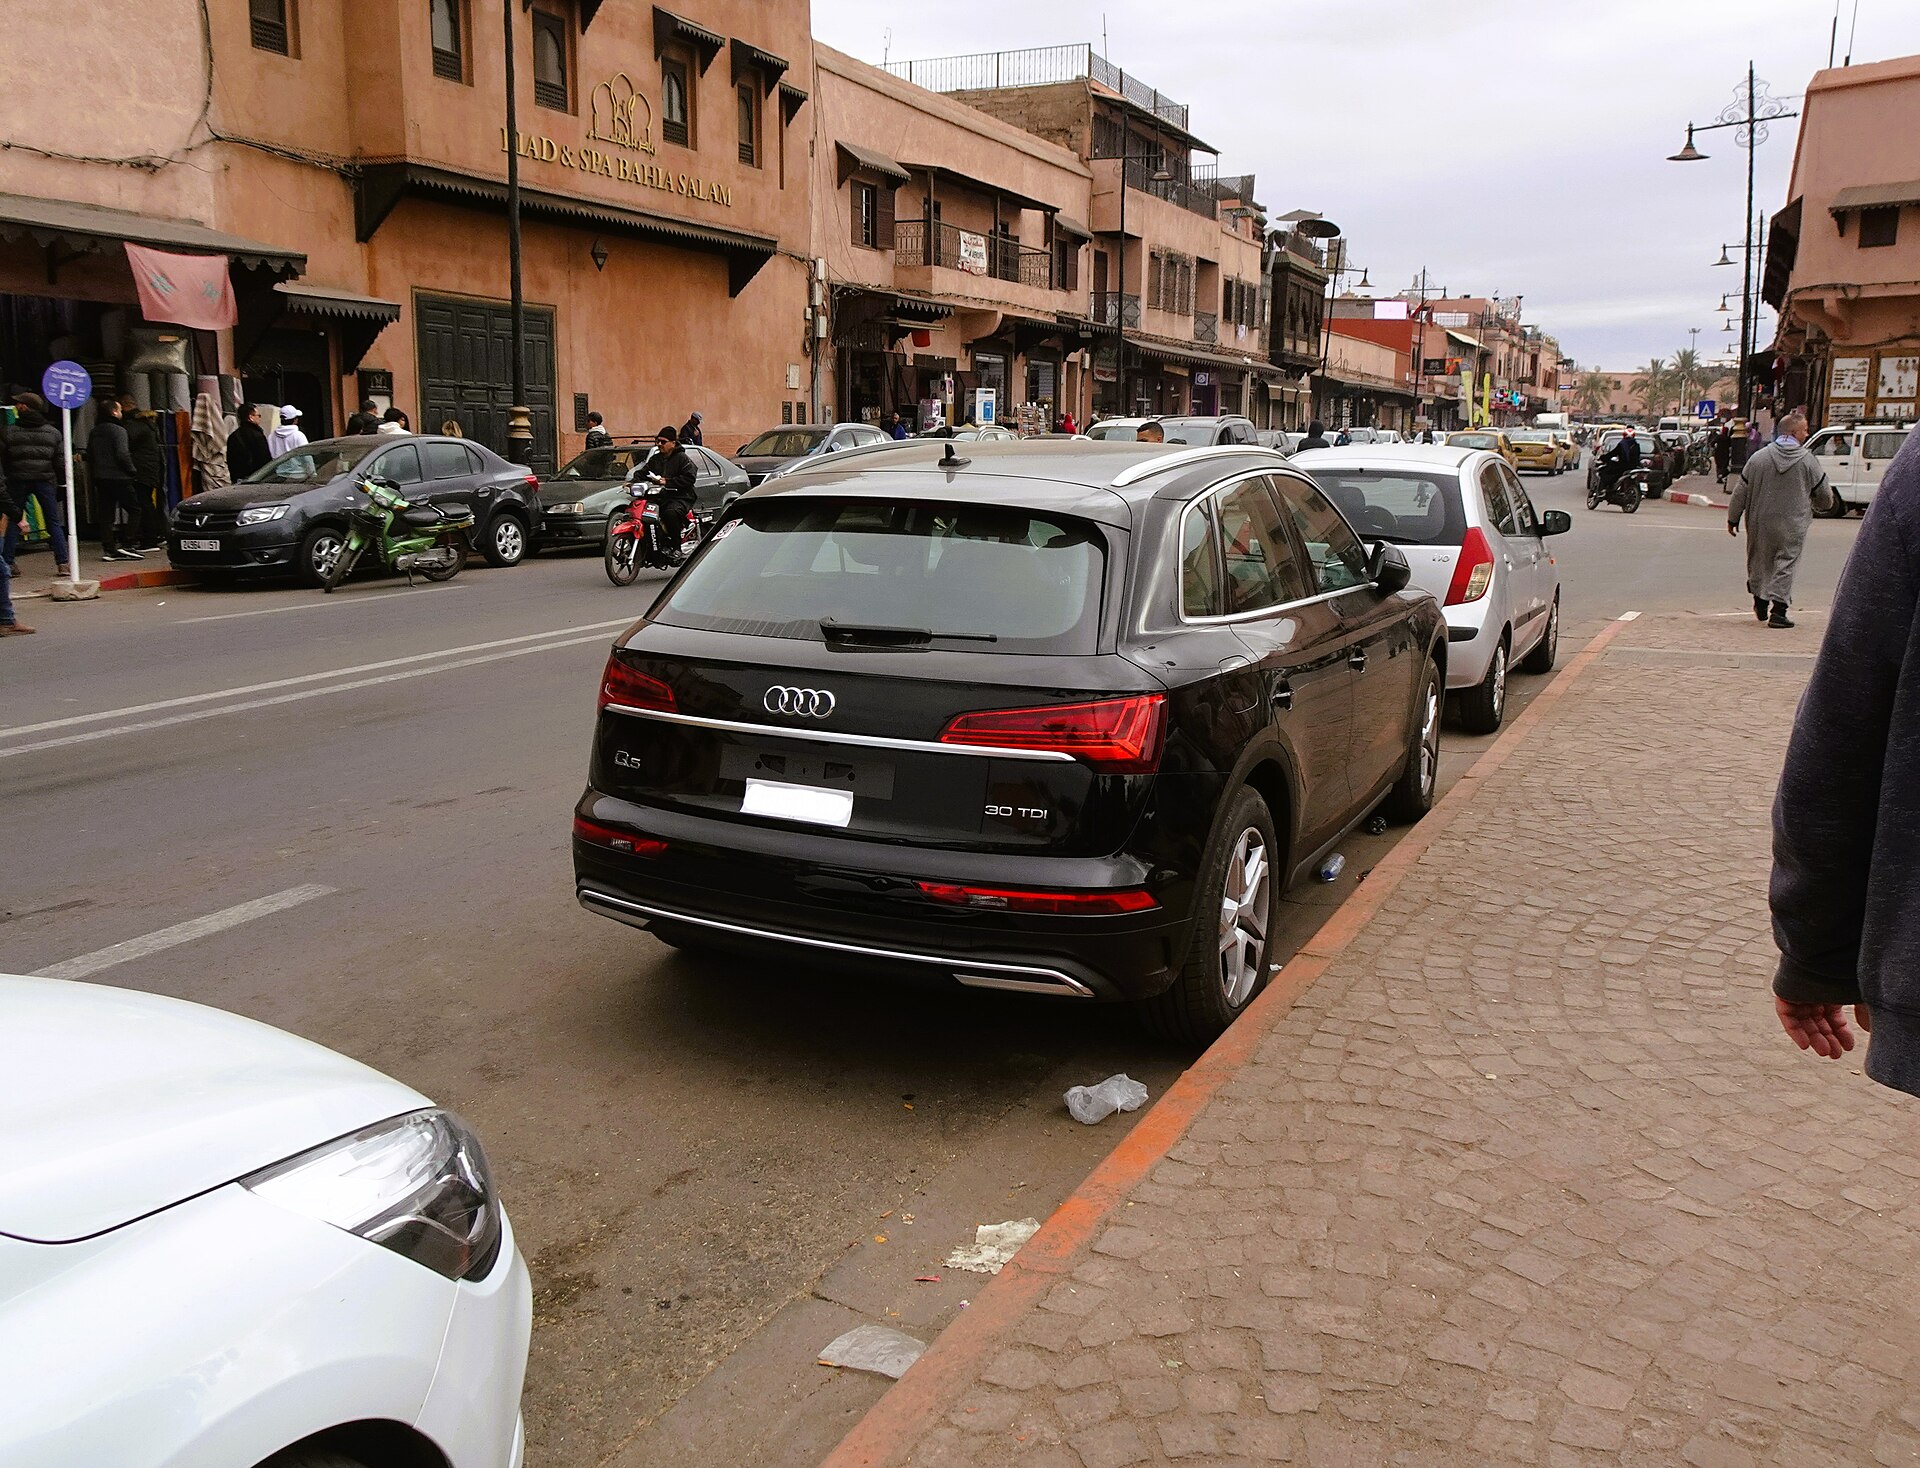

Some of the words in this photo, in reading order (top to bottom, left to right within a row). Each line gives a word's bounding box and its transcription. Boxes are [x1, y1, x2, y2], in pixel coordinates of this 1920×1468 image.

[560, 144, 575, 168] &
[579, 148, 613, 178] SPA
[617, 157, 675, 193] BAHIA
[677, 173, 732, 207] SALAM
[60, 382, 75, 400] P
[1432, 552, 1450, 562] i10
[615, 750, 641, 769] Q5
[984, 805, 1013, 817] 30
[1017, 807, 1048, 819] TDI
